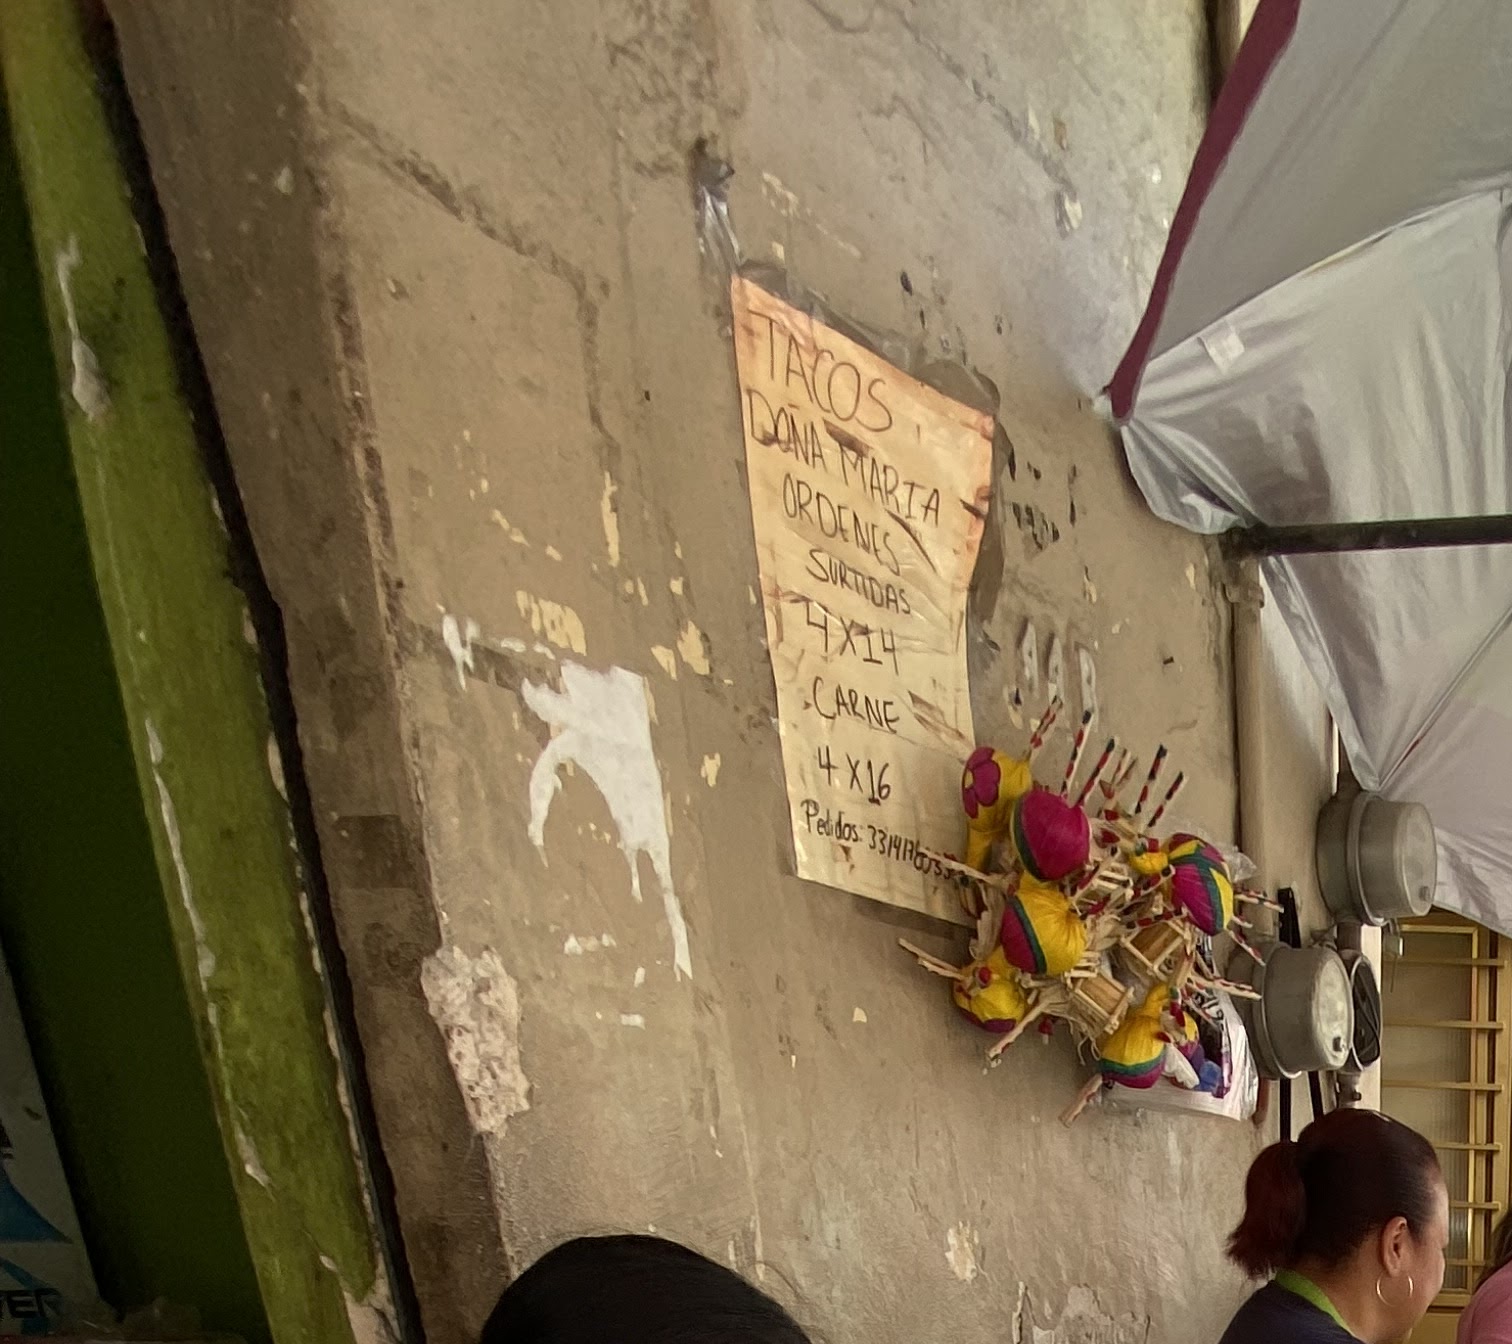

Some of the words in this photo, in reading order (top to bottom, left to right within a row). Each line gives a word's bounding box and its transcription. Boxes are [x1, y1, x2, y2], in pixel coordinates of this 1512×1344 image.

[748, 309, 892, 432] TACOS
[746, 388, 827, 473] DOÑA
[839, 442, 940, 528] MARIA
[783, 472, 900, 577] ORDENES
[805, 548, 911, 615] SURTIDAS
[813, 676, 899, 734] CARNE
